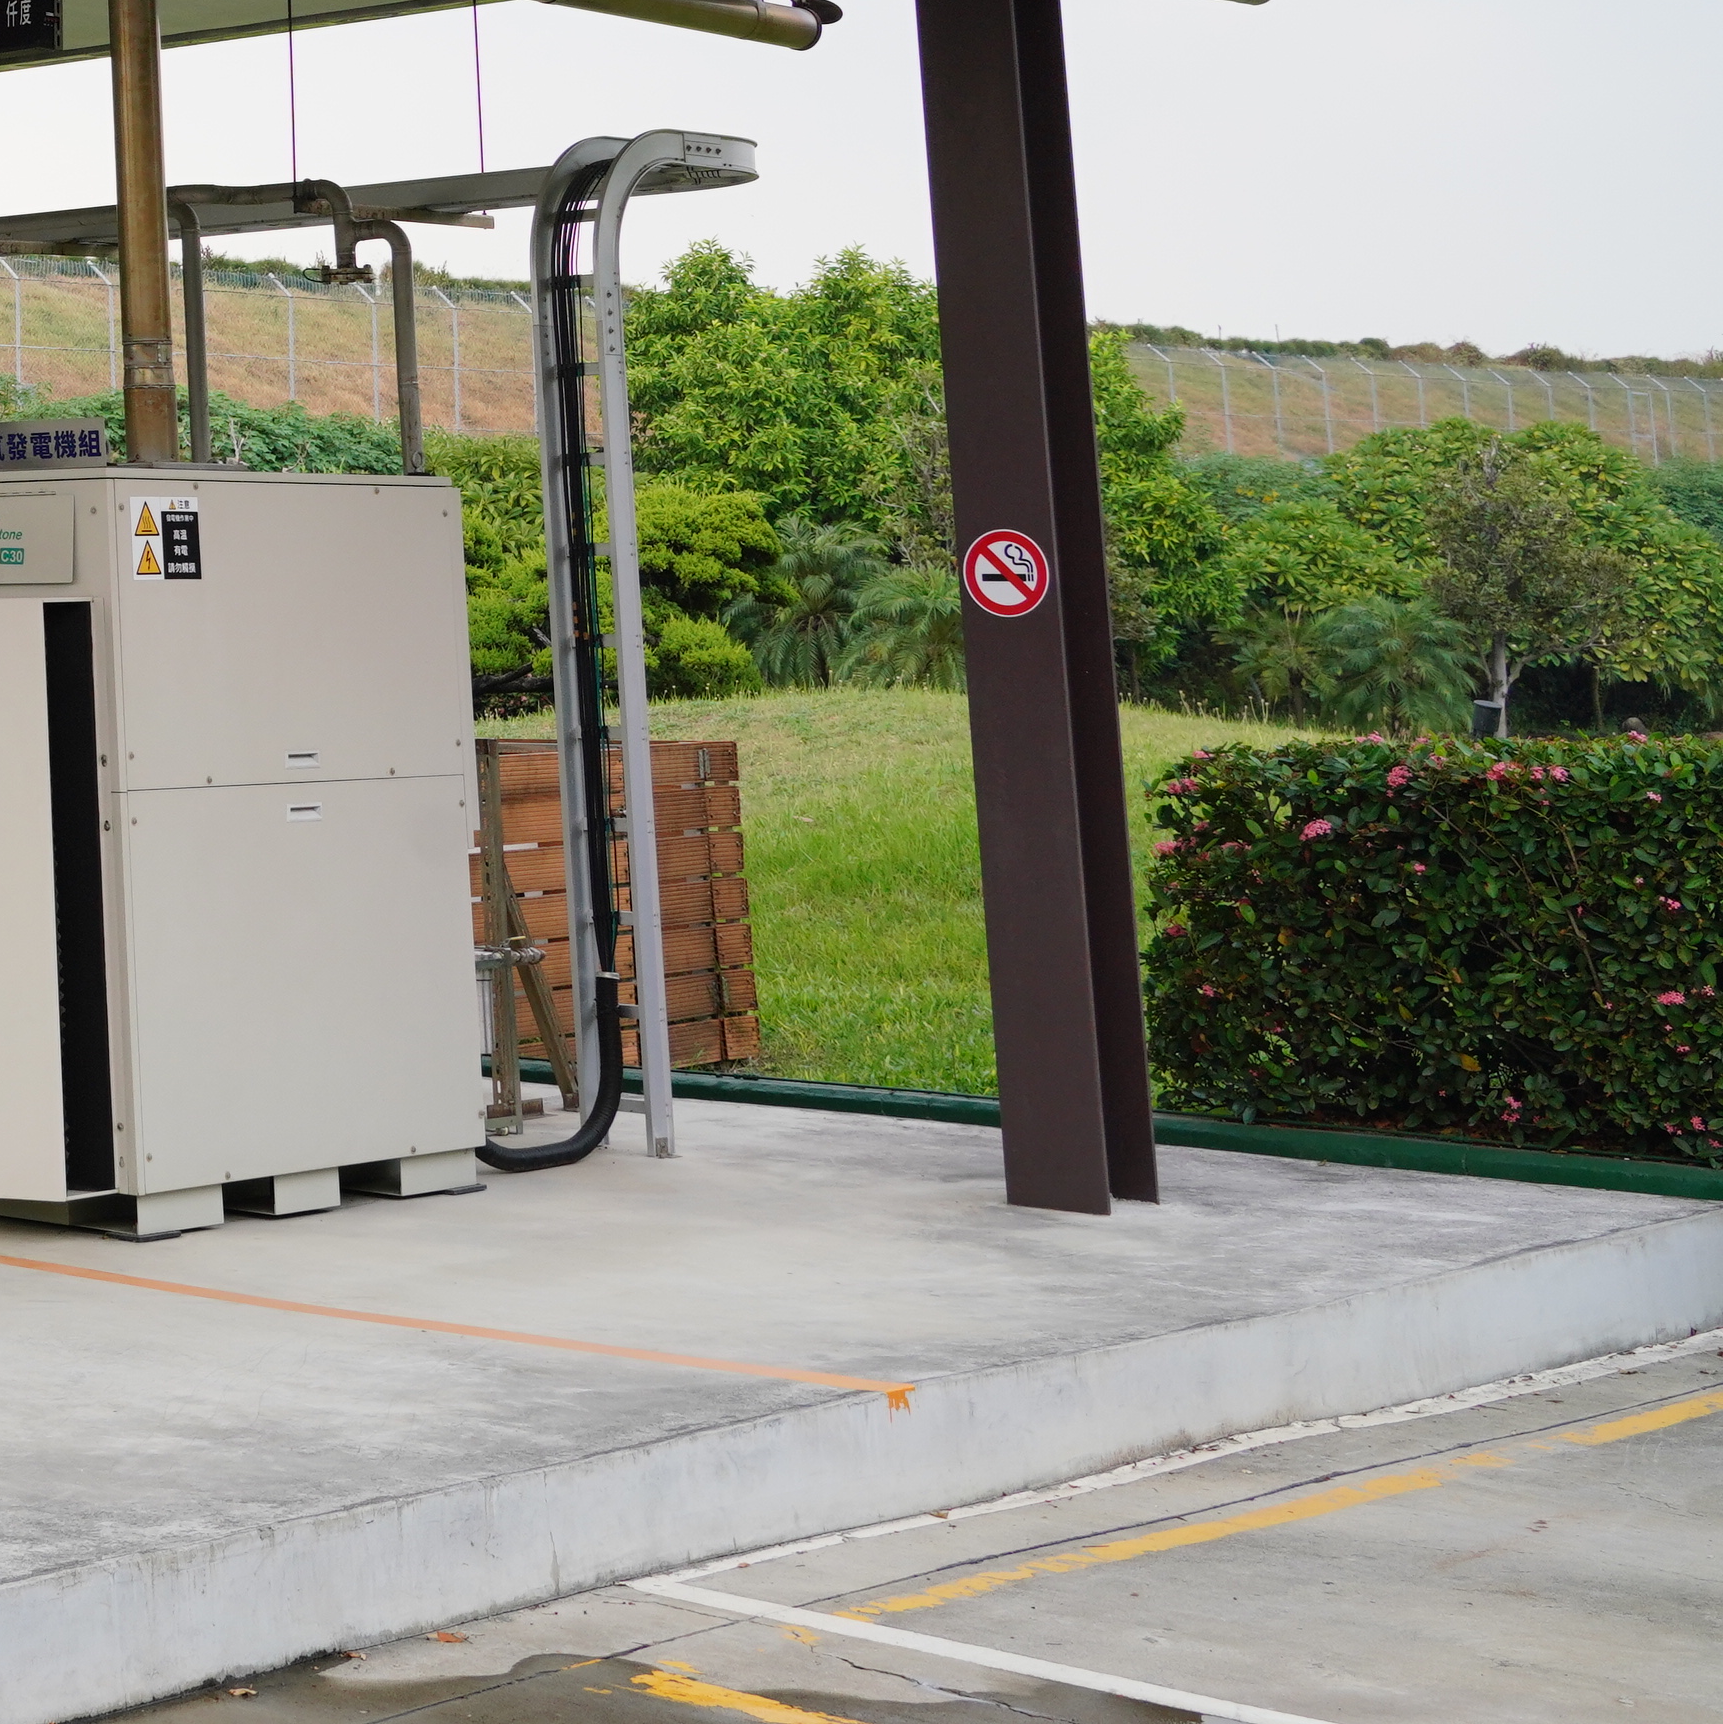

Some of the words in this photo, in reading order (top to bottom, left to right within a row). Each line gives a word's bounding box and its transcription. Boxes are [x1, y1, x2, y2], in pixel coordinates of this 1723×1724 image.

[172, 529, 188, 541] 高溫
[1, 549, 23, 564] C30
[173, 544, 189, 557] 有電
